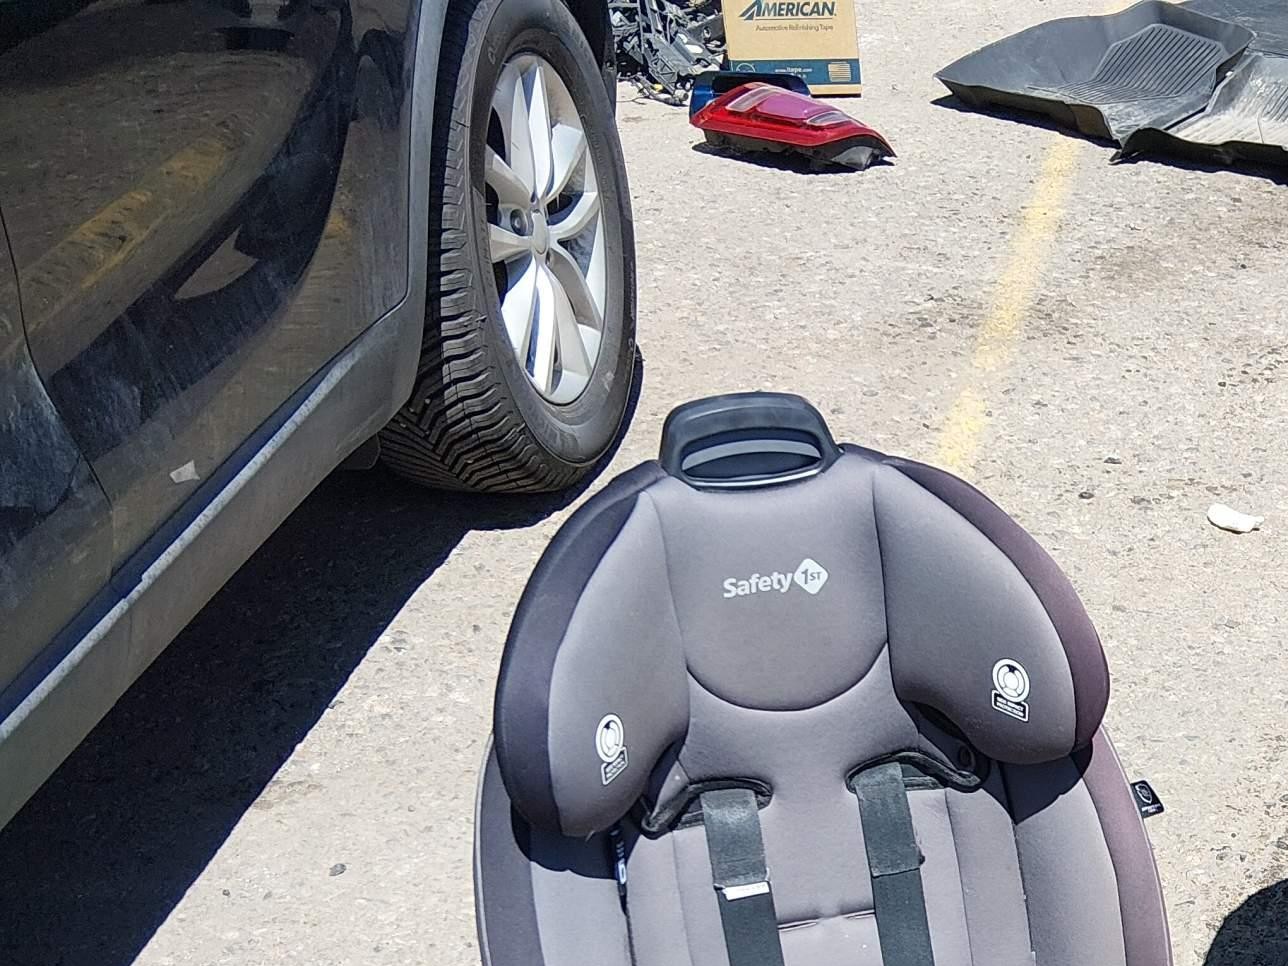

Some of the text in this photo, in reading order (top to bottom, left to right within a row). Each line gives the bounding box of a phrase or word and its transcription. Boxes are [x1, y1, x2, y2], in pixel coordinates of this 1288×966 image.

[739, 0, 835, 20] AMERICAN
[820, 24, 833, 32] Tape
[723, 572, 793, 598] Safety
